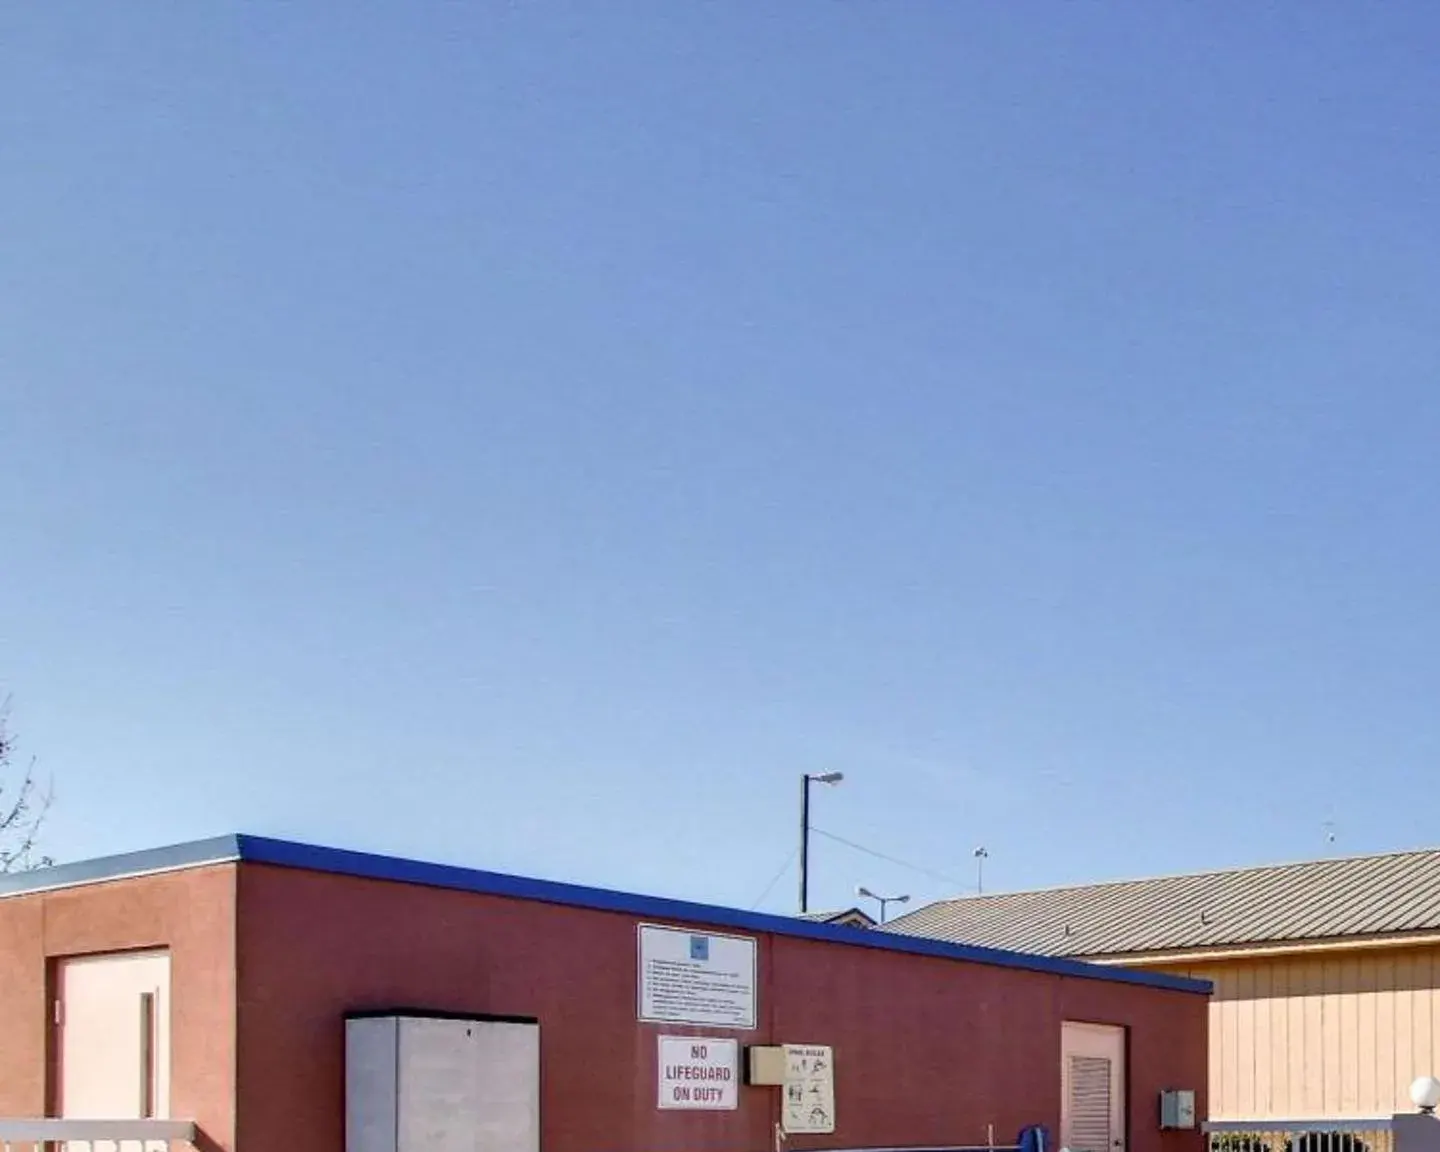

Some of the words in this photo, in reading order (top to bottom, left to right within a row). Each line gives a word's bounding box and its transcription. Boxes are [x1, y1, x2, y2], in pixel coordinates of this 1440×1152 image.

[691, 1045, 707, 1060] NO
[665, 1065, 731, 1081] LIFEGUARD
[673, 1086, 690, 1102] ON
[694, 1087, 723, 1103] DUTY
